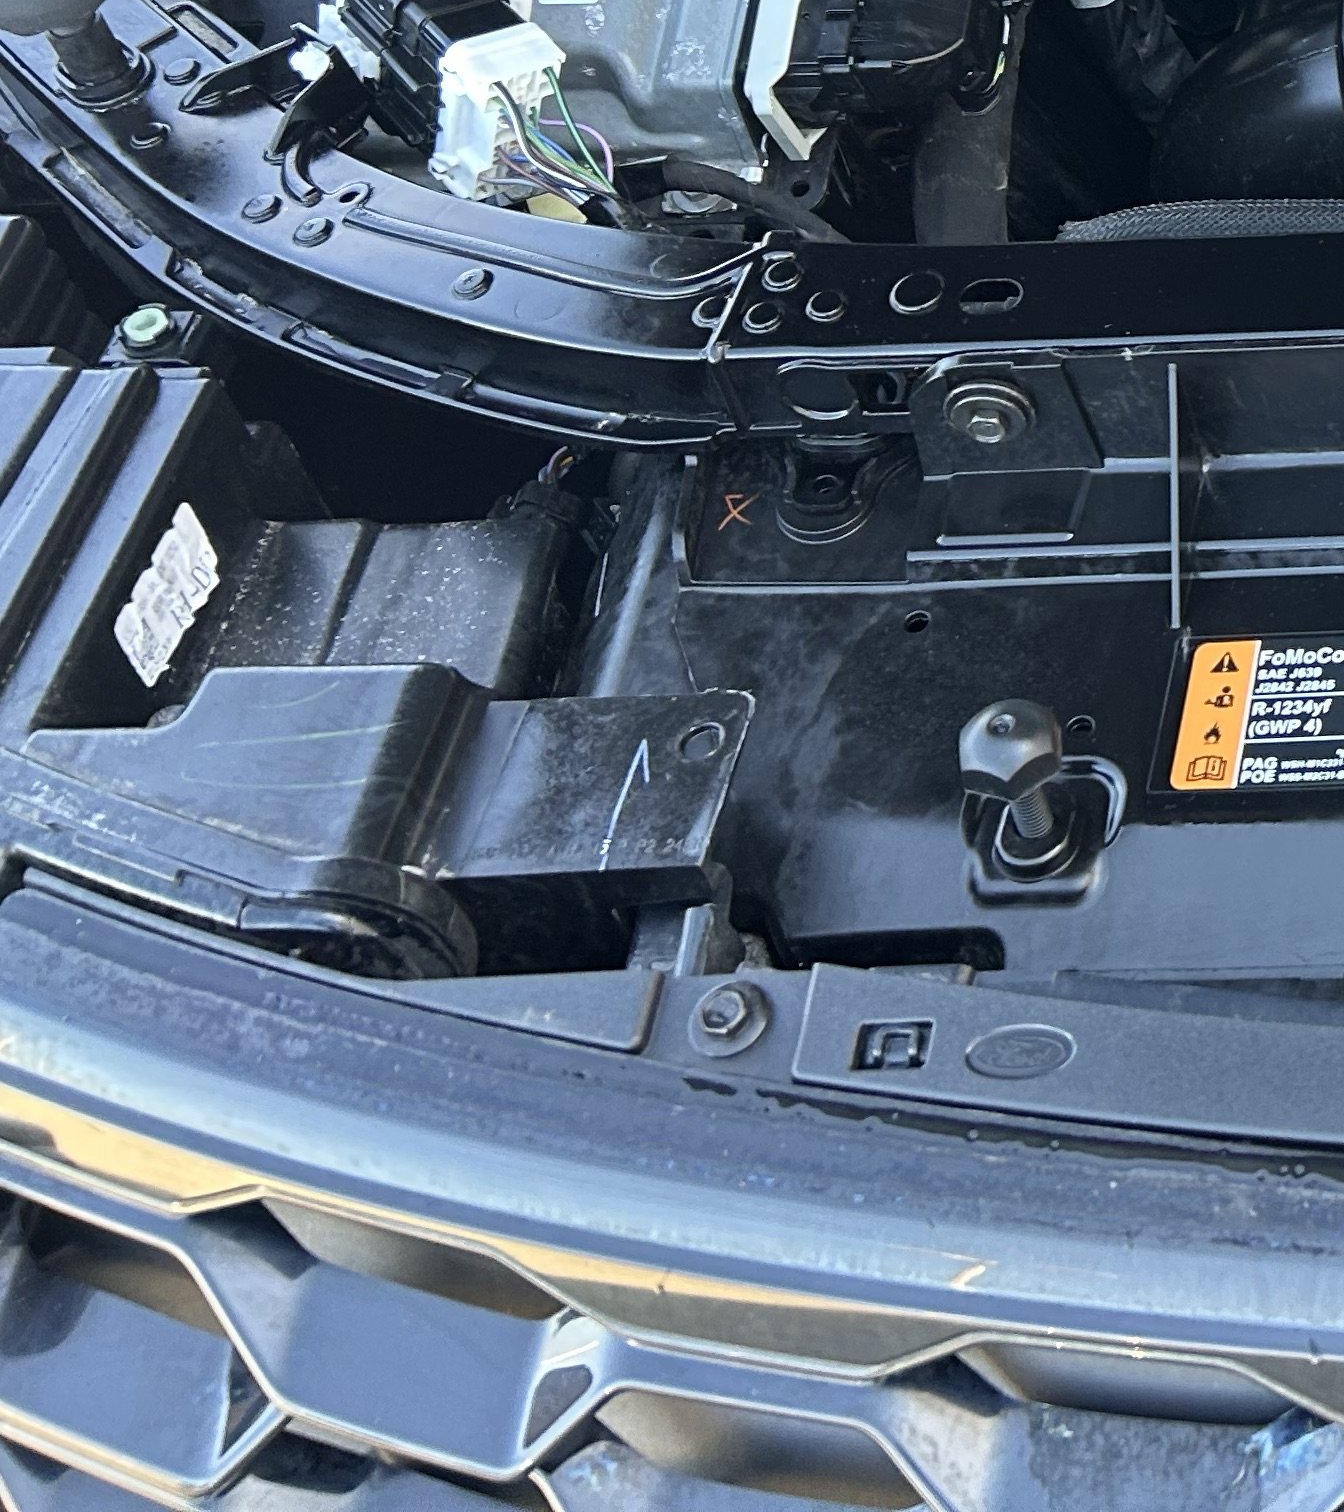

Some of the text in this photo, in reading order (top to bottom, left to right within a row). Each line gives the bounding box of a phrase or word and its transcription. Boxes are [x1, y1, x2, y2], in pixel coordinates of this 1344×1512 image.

[1257, 667, 1323, 680] SAE J639
[1251, 698, 1333, 717] R-1234yf
[1248, 718, 1323, 738] (GWP 4)
[1242, 757, 1278, 771] PAG
[1239, 769, 1277, 784] POE
